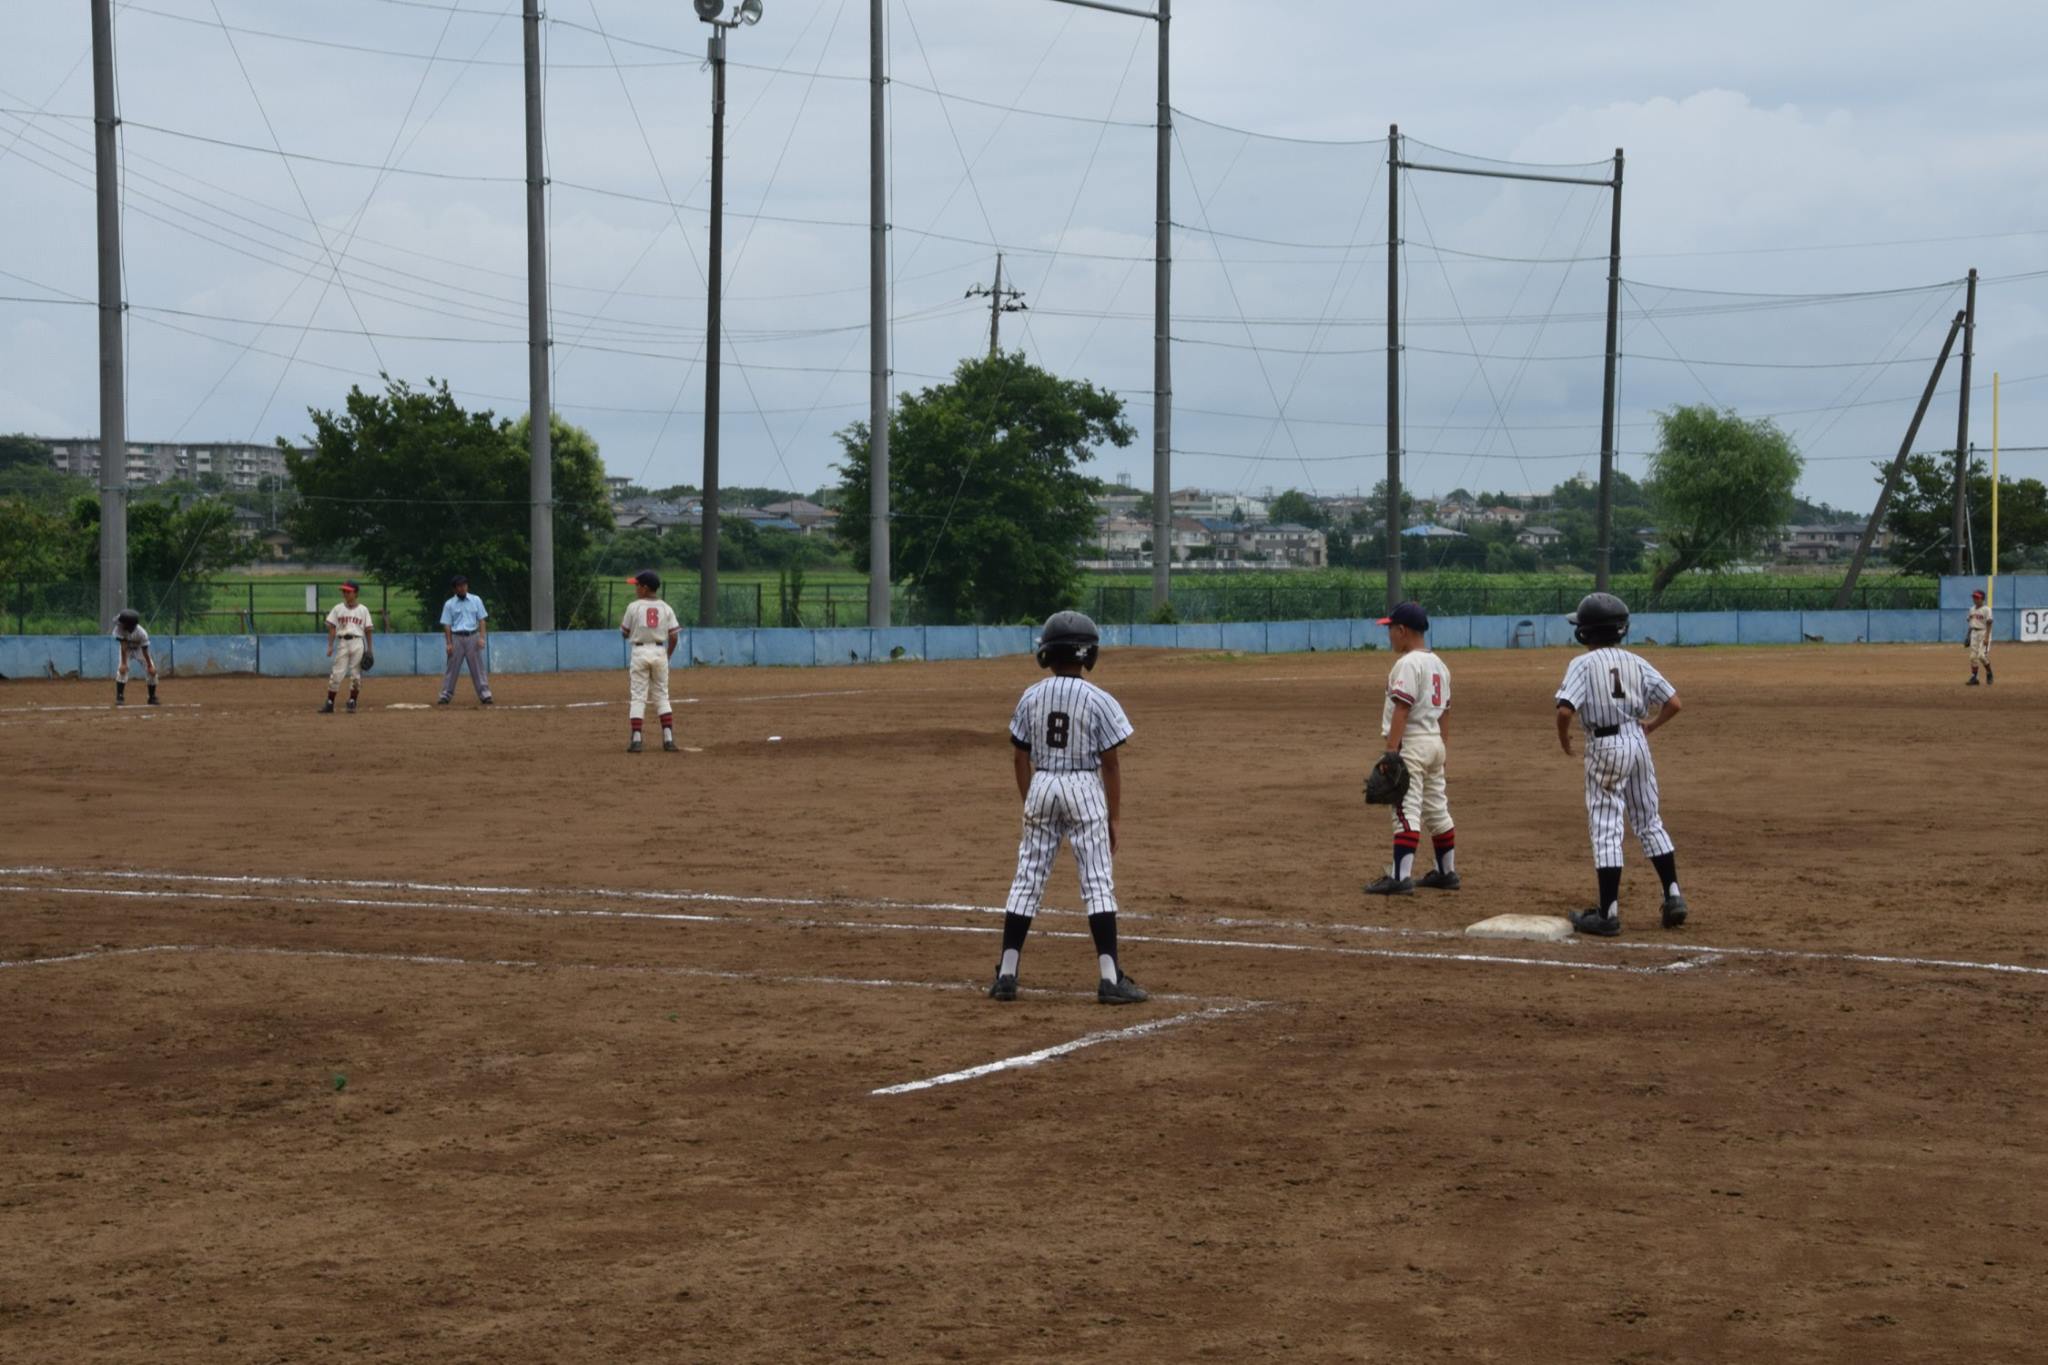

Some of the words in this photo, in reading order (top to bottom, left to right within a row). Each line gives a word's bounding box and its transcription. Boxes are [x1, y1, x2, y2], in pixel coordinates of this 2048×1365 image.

[1432, 673, 1441, 706] 3
[1610, 668, 1626, 699] 1
[1046, 711, 1070, 749] 8
